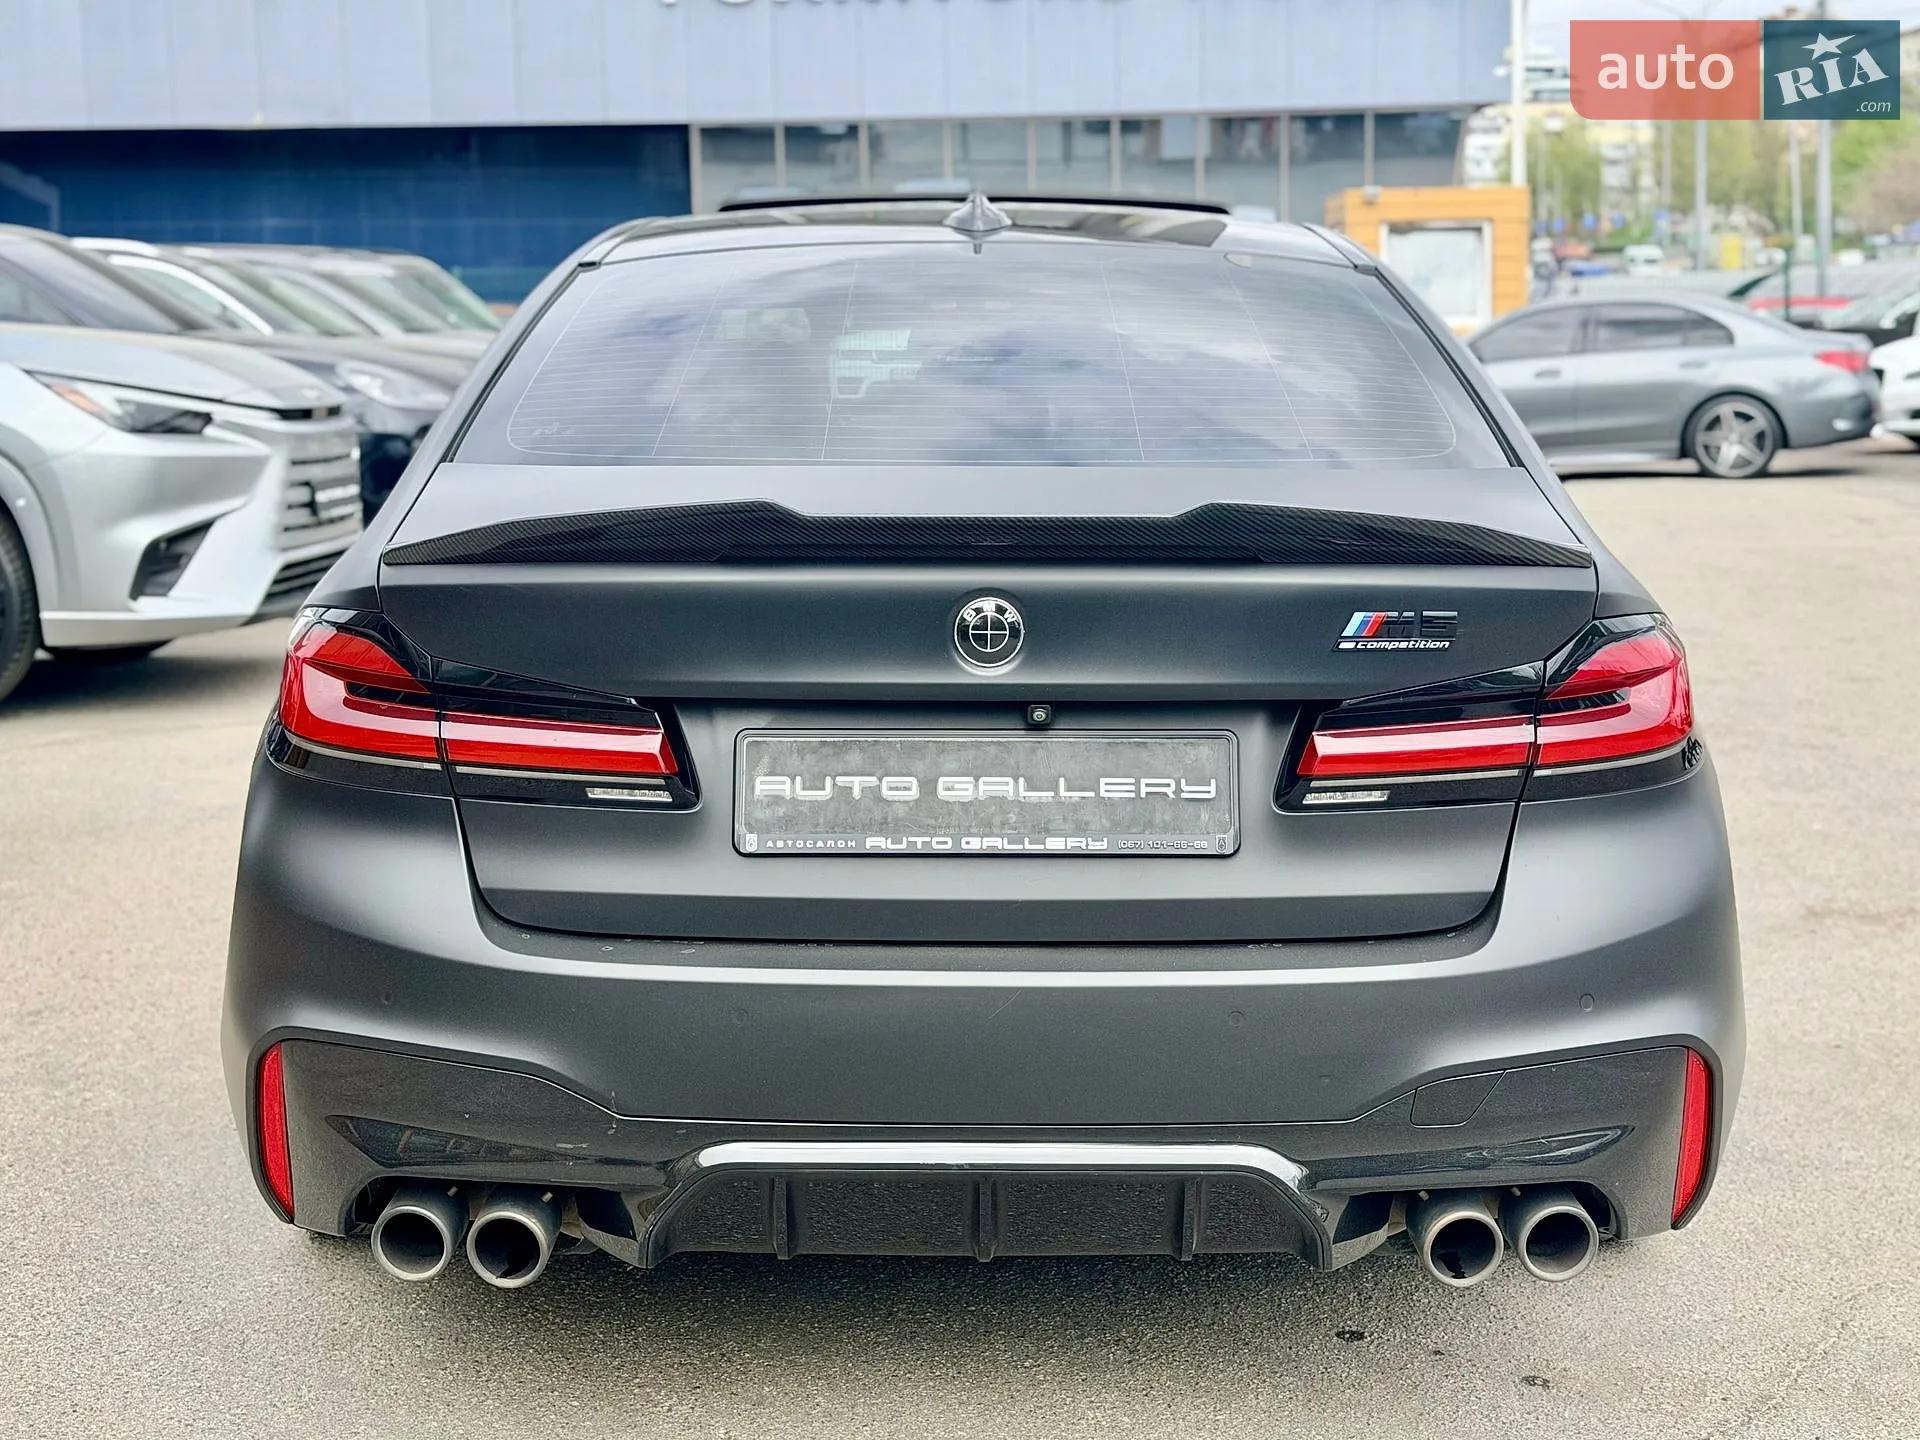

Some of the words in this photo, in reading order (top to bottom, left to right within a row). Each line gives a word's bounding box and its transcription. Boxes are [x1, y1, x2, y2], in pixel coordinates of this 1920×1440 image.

[962, 601, 1017, 623] BMW
[1356, 639, 1451, 651] competition
[752, 775, 921, 801] AUTO
[935, 775, 1218, 801] GALLERY
[765, 839, 857, 849] АВТОСАЛОН
[865, 836, 953, 850] AUTO
[960, 836, 1108, 850] GALLERY
[1117, 840, 1145, 850] (067)
